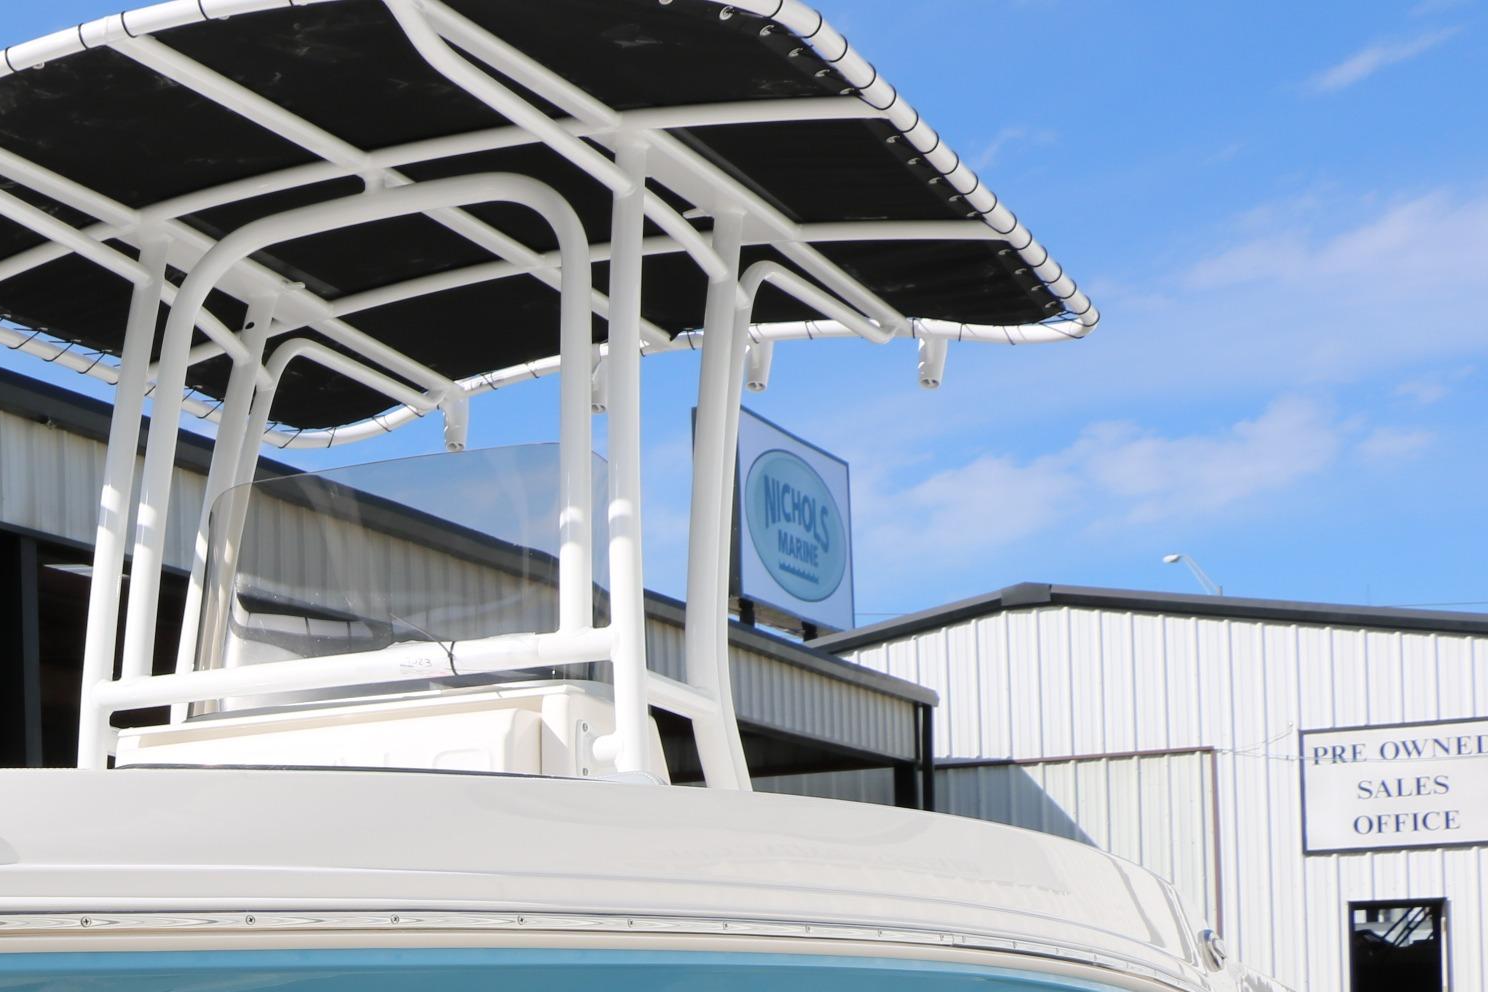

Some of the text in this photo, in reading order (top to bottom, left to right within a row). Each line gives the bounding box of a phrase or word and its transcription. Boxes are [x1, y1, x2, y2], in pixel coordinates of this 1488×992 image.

[764, 475, 829, 553] NICHOLS
[778, 529, 818, 568] MARINE
[1312, 743, 1367, 765] PRE
[1357, 775, 1450, 800] SALES
[1353, 810, 1461, 835] OFFICE
